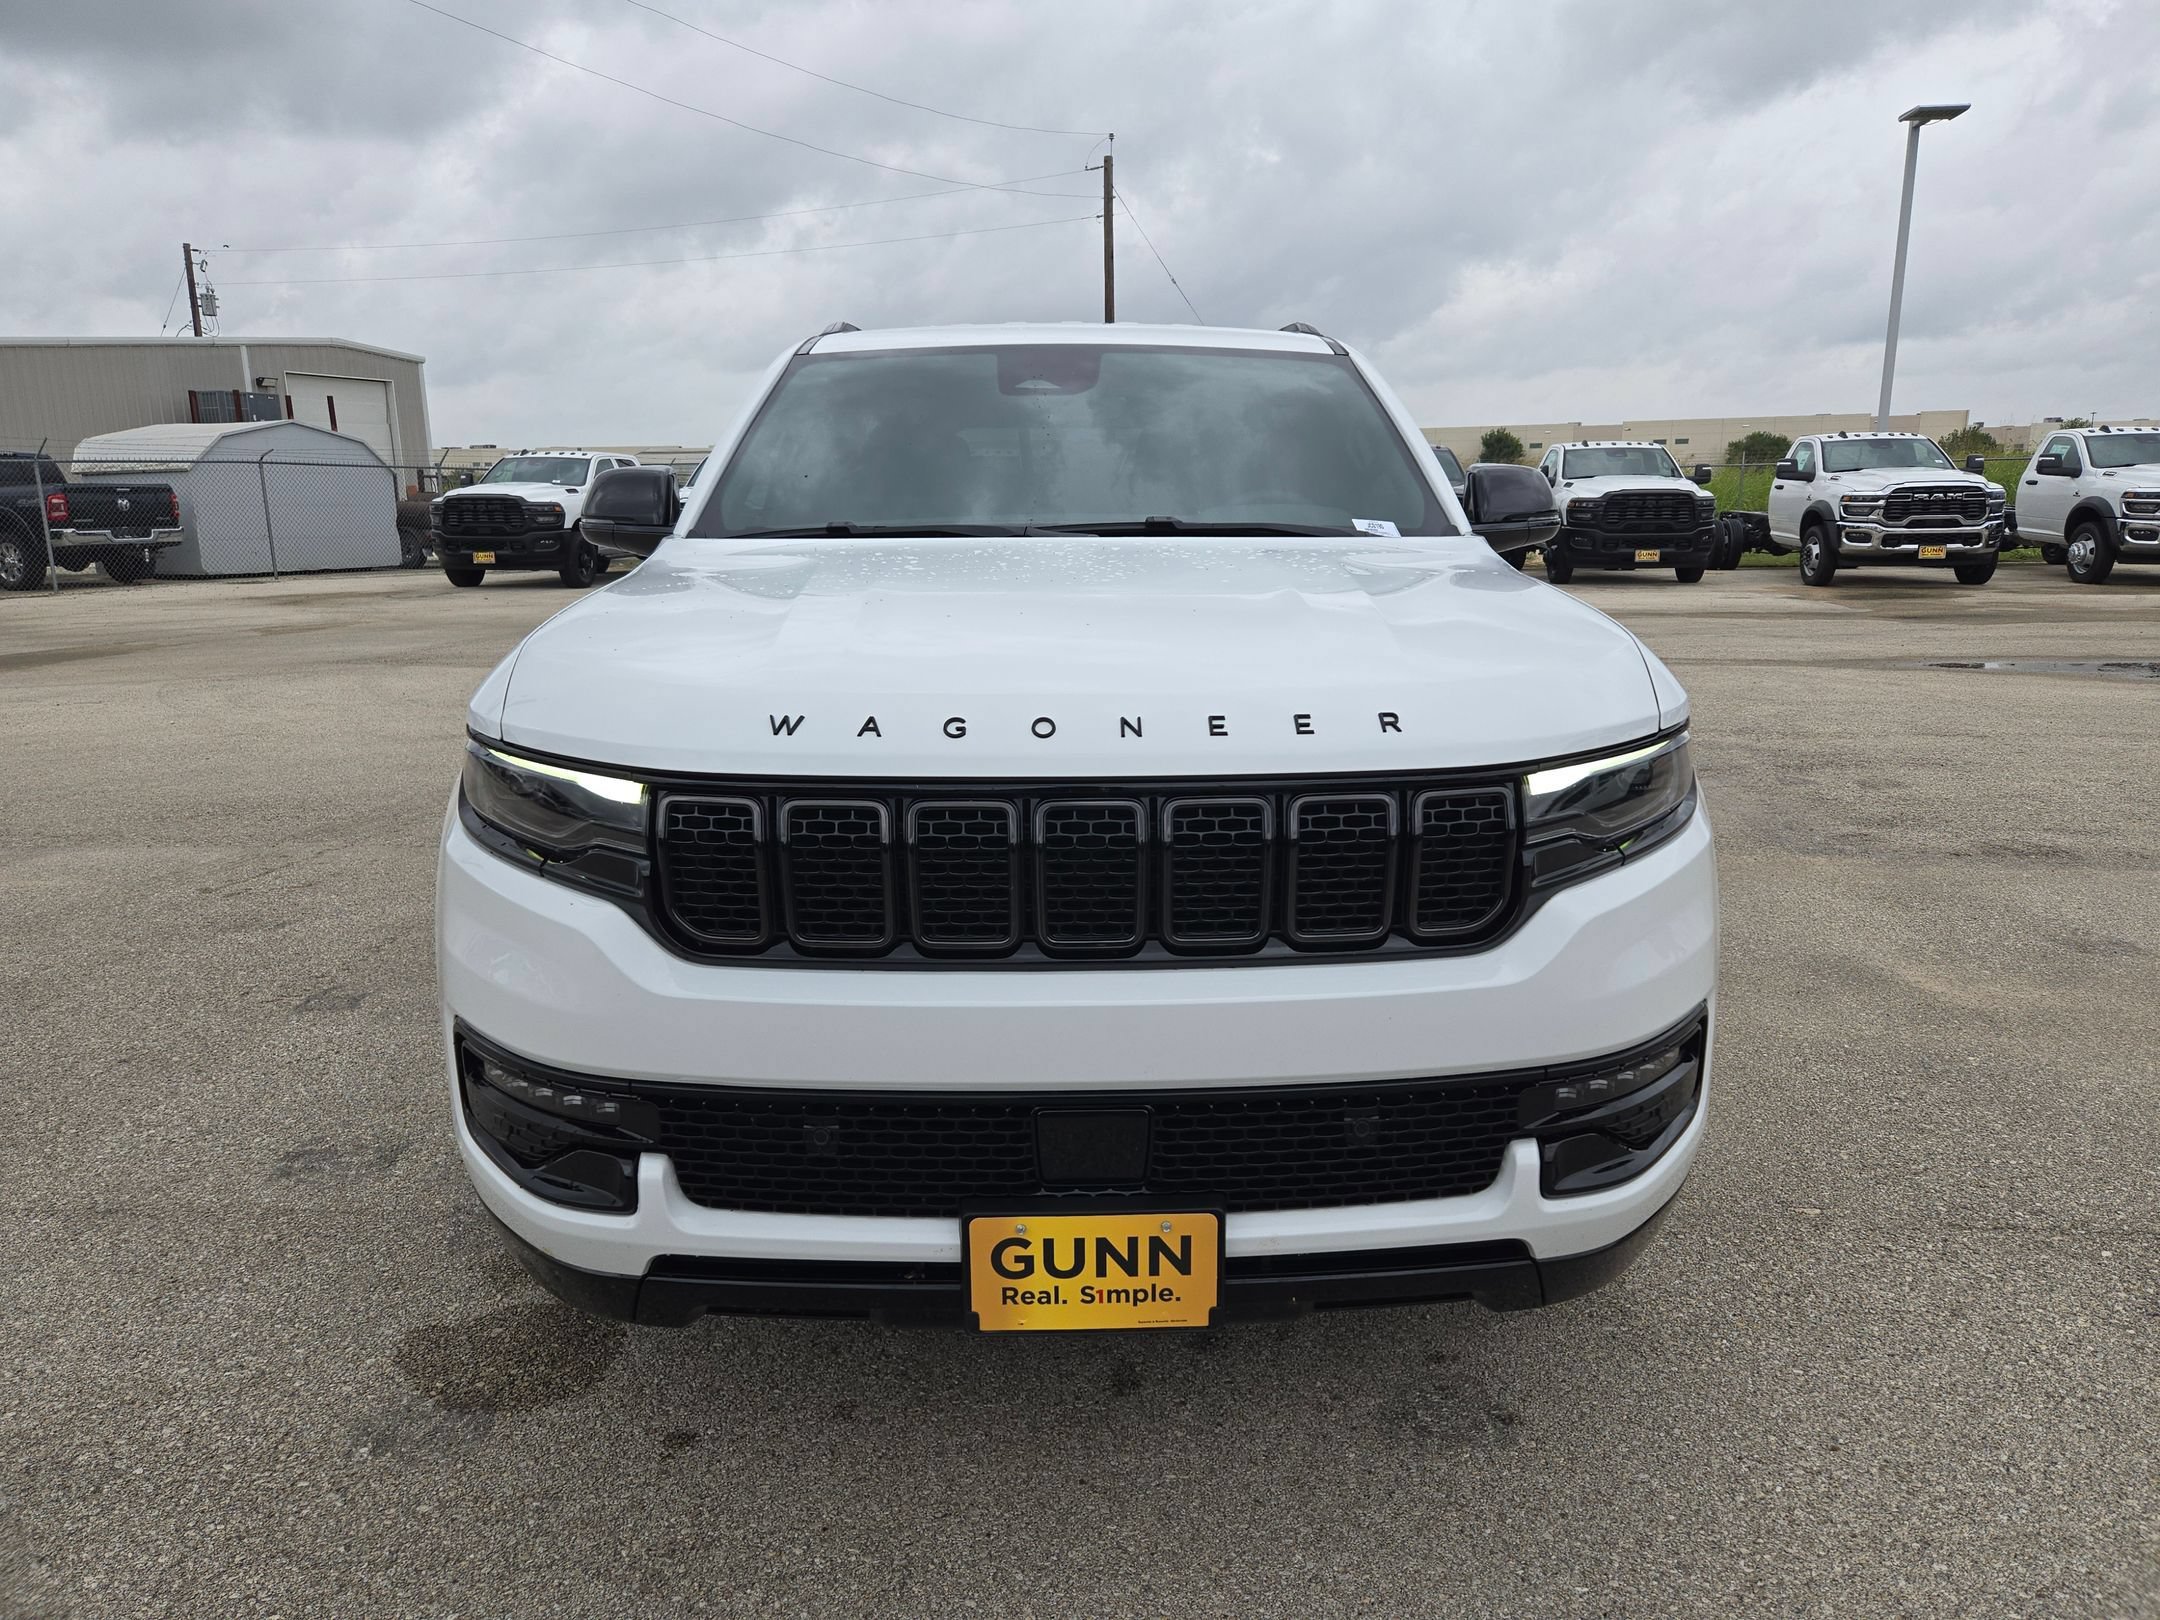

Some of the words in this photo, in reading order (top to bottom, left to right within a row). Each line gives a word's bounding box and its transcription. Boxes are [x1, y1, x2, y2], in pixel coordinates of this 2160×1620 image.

[1913, 492, 1963, 501] RAM
[769, 711, 1403, 739] WAGONEER
[990, 1235, 1192, 1280] GUNN
[1001, 1285, 1068, 1306] Real.
